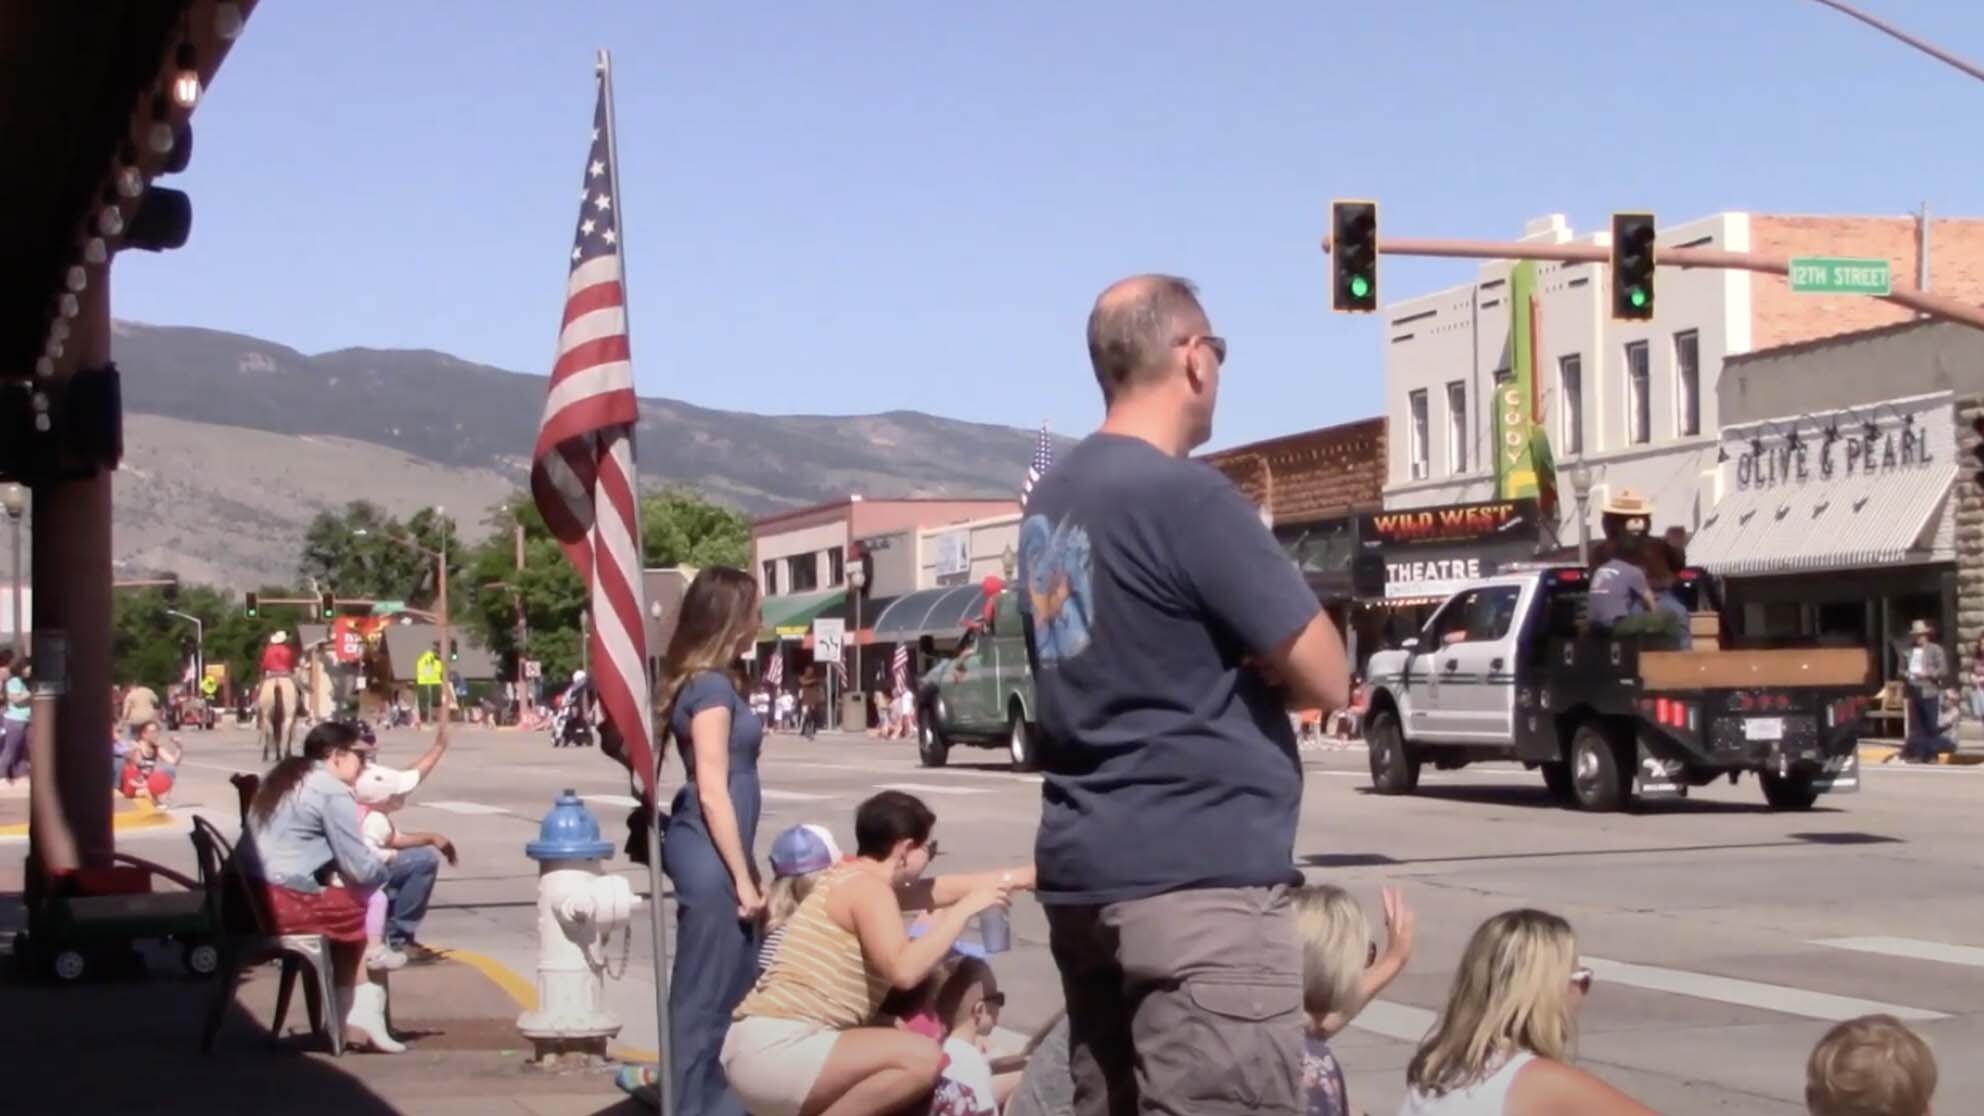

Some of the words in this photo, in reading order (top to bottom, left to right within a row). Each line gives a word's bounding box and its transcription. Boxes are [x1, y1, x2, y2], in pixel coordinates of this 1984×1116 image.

[1792, 265, 1827, 285] 12TH
[1833, 266, 1886, 287] STREET
[1737, 441, 1808, 487] OLIVE
[1846, 427, 1933, 472] PEARL
[1374, 512, 1433, 533] WILD
[1440, 504, 1513, 527] WEST
[1386, 558, 1480, 583] THEATRE
